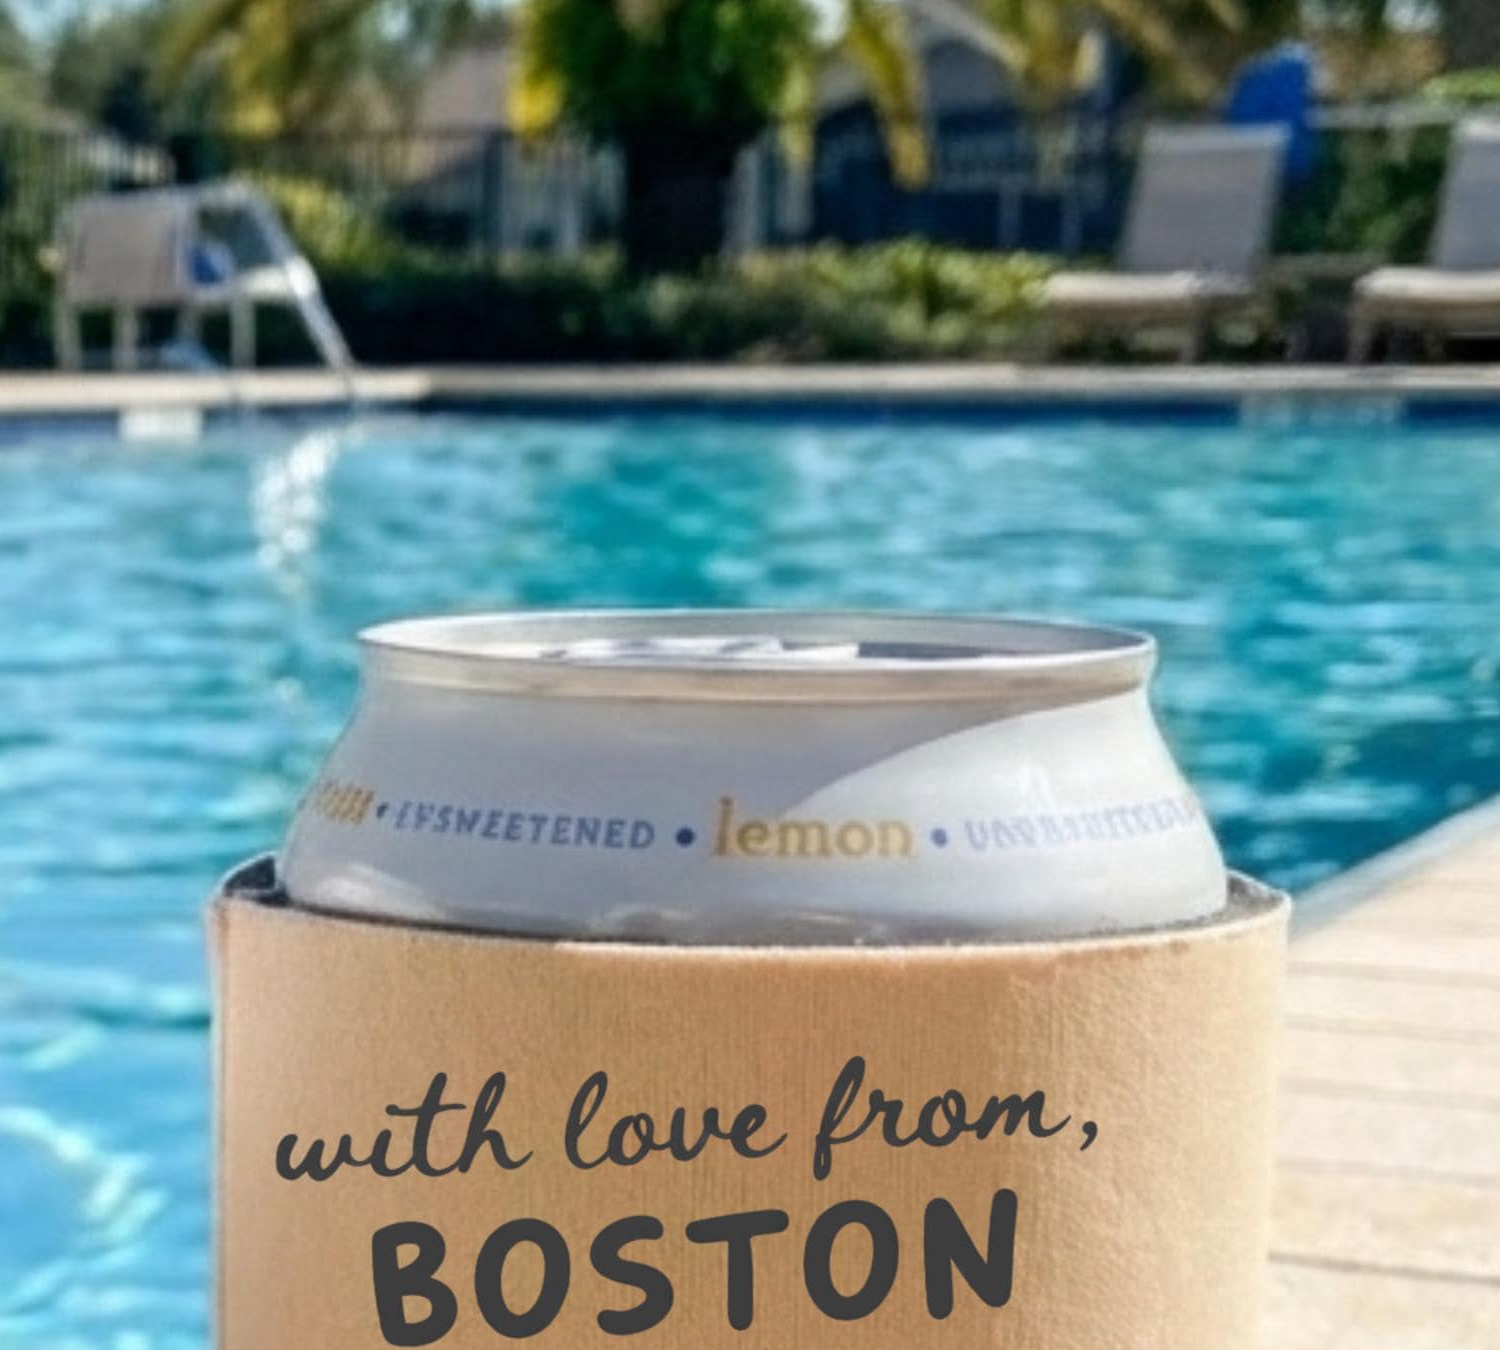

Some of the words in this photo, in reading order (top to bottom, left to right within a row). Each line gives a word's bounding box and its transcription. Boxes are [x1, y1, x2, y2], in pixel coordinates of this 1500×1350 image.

[713, 794, 914, 857] lemon
[275, 1071, 534, 1182] with
[564, 1070, 788, 1170] love
[812, 1055, 1098, 1182] from,
[371, 1188, 1019, 1348] BOSTON
